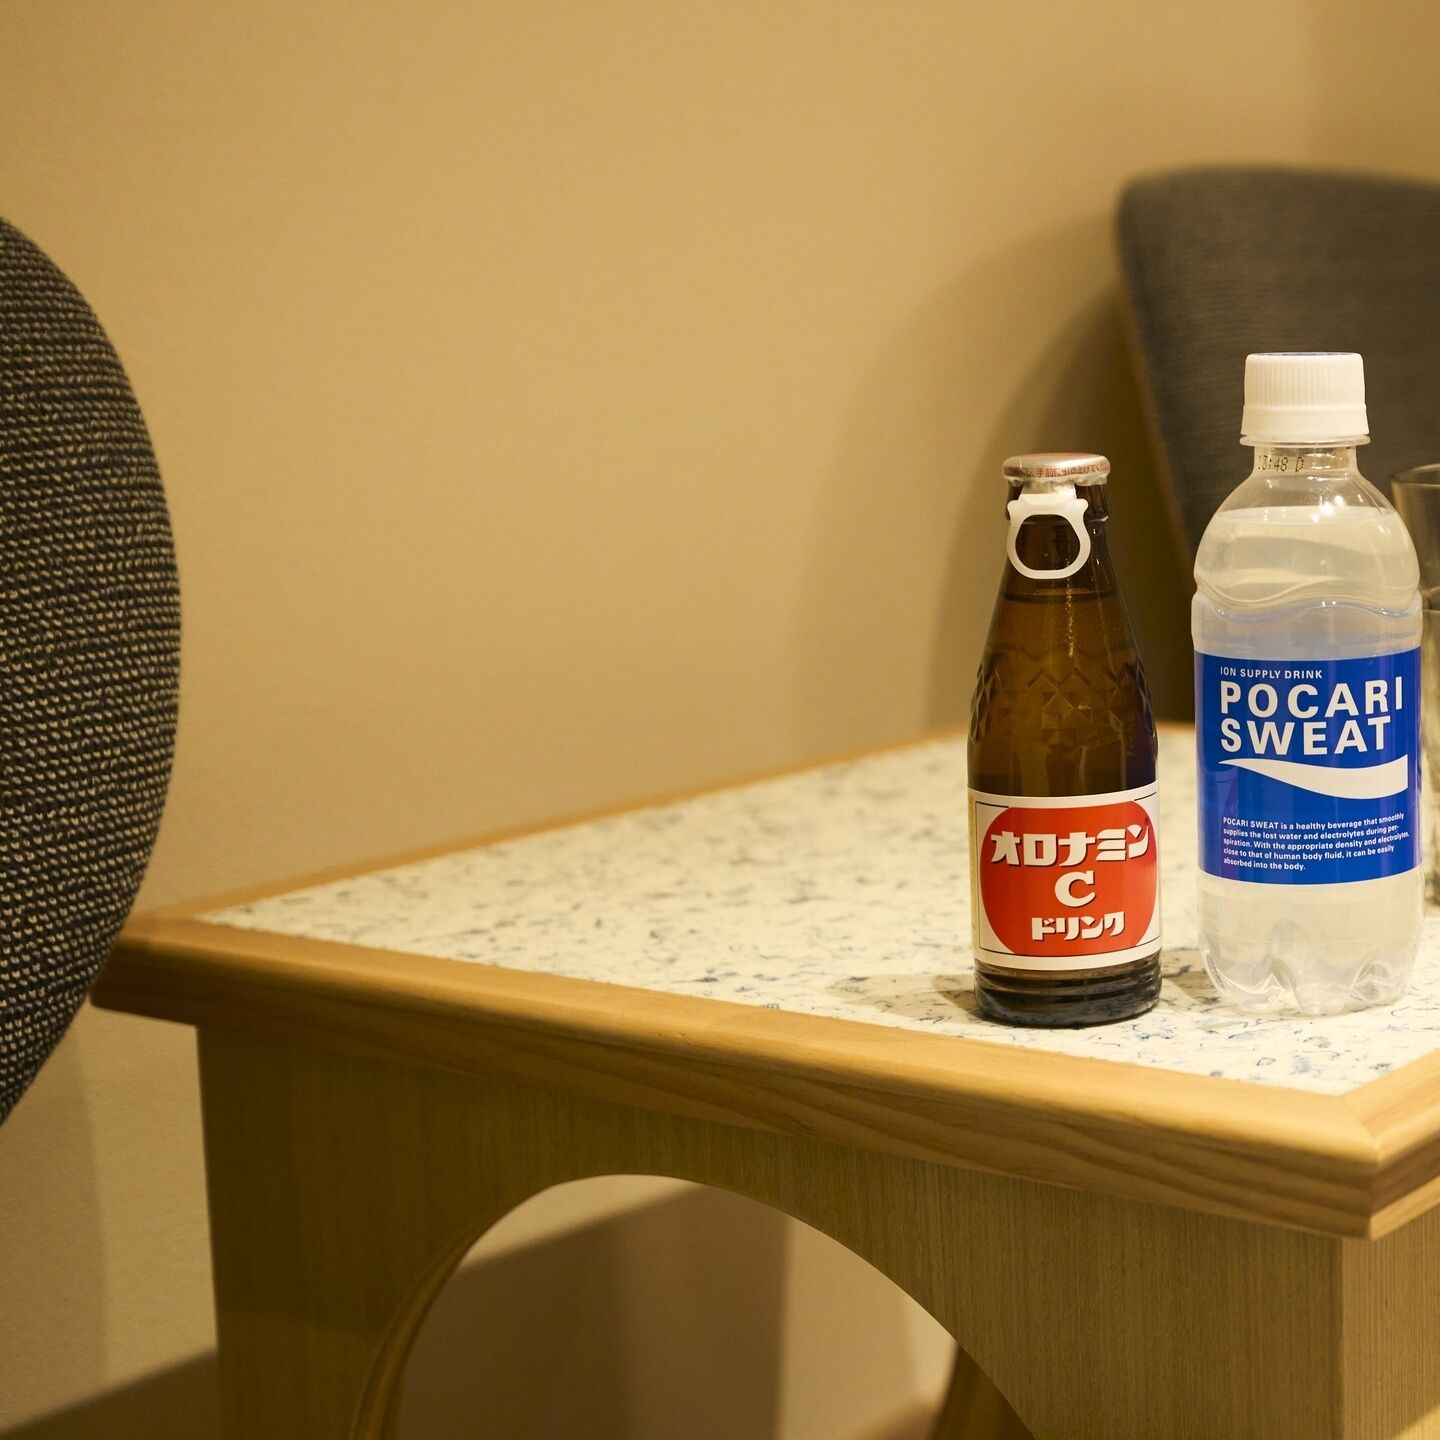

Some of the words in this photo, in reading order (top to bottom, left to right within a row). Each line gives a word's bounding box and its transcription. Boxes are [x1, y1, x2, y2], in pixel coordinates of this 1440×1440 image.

[1220, 666, 1237, 677] ION
[1240, 668, 1281, 679] SUPPLY
[1284, 669, 1323, 679] DRINK
[1220, 676, 1402, 719] POCARI
[1220, 715, 1391, 756] SWEAT
[1223, 816, 1248, 827] POCARI
[1250, 820, 1279, 829] SWEAT
[1281, 822, 1288, 830] is
[1296, 822, 1325, 830] healthy
[1328, 820, 1362, 829] beverage
[1364, 818, 1378, 826] that
[1379, 812, 1405, 824] smoothly
[1223, 828, 1249, 837] supplies
[1250, 830, 1261, 838] the
[1303, 832, 1319, 840] and
[1320, 830, 1365, 839] electrolytes
[1366, 826, 1387, 835] during
[1388, 824, 1399, 833] per-
[990, 824, 1149, 867] オロナミン
[1223, 838, 1252, 848] spiration.
[1253, 841, 1271, 849] With
[1272, 842, 1285, 850] the
[1287, 842, 1334, 851] appropriate
[1335, 840, 1363, 849] density
[1364, 838, 1377, 846] and
[1223, 847, 1239, 856] close
[1240, 849, 1247, 857] to
[1273, 852, 1301, 860] human
[1302, 852, 1323, 861] body
[1346, 850, 1352, 858] it
[1367, 848, 1376, 856] be
[1377, 845, 1395, 854] easily
[1223, 857, 1252, 868] absorbed
[1253, 861, 1268, 869] into
[1269, 862, 1282, 870] the
[1284, 863, 1306, 872] body.
[1054, 870, 1096, 908] C
[1031, 911, 1125, 941] ドリンク
